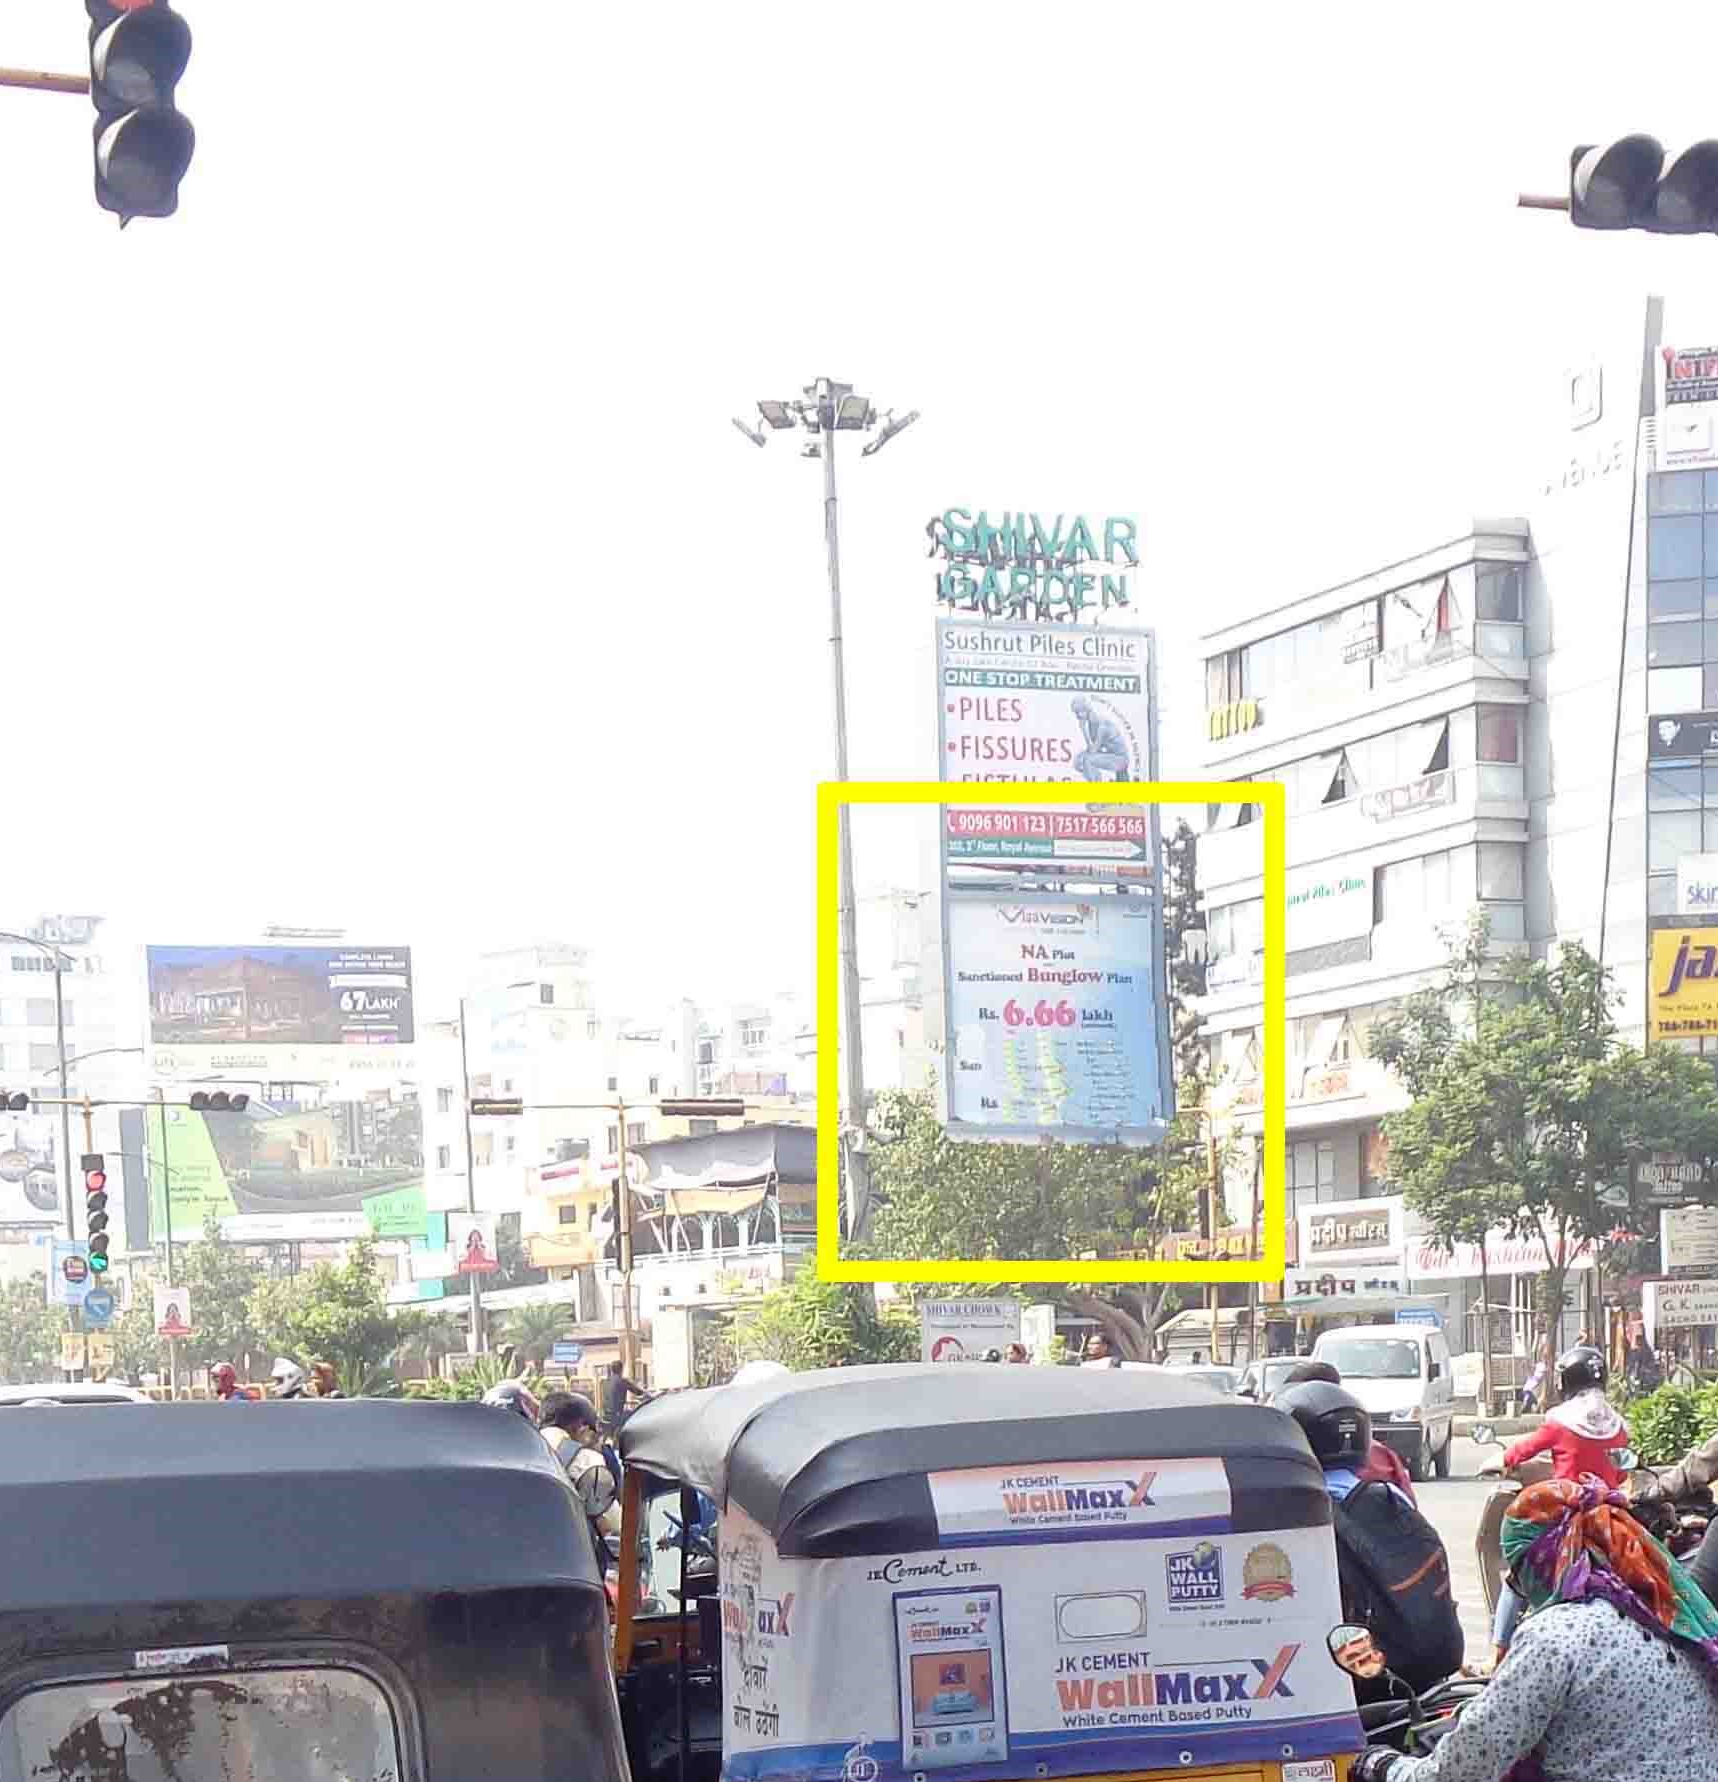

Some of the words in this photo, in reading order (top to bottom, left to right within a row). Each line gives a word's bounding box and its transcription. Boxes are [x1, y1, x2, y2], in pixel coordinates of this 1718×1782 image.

[944, 631, 1023, 653] Sushrut
[1030, 635, 1076, 656] Piles
[1082, 637, 1136, 659] Clinic
[945, 669, 981, 685] ONE
[985, 671, 1031, 687] STOP
[1034, 673, 1136, 692] TREATMENT
[959, 696, 1023, 722] PILES
[960, 735, 1073, 763] FISSURES
[958, 814, 992, 833] 9096
[1021, 944, 1049, 960] NA
[958, 970, 1023, 982] Sanctioned
[1027, 967, 1104, 985] Bunglow
[340, 990, 366, 1012] 67
[1002, 999, 1077, 1027] 6.66
[1020, 1475, 1060, 1488] CEMENT
[883, 1555, 955, 1585] Cement
[1169, 1558, 1193, 1572] JK
[1169, 1571, 1219, 1587] WALL
[1169, 1583, 1220, 1599] PUTTY
[1055, 1655, 1077, 1674] JK
[1082, 1651, 1152, 1672] CEMENT
[1062, 1711, 1106, 1729] White
[1109, 1710, 1164, 1725] Cement
[1169, 1707, 1213, 1722] Based
[1216, 1705, 1253, 1722] Putty
